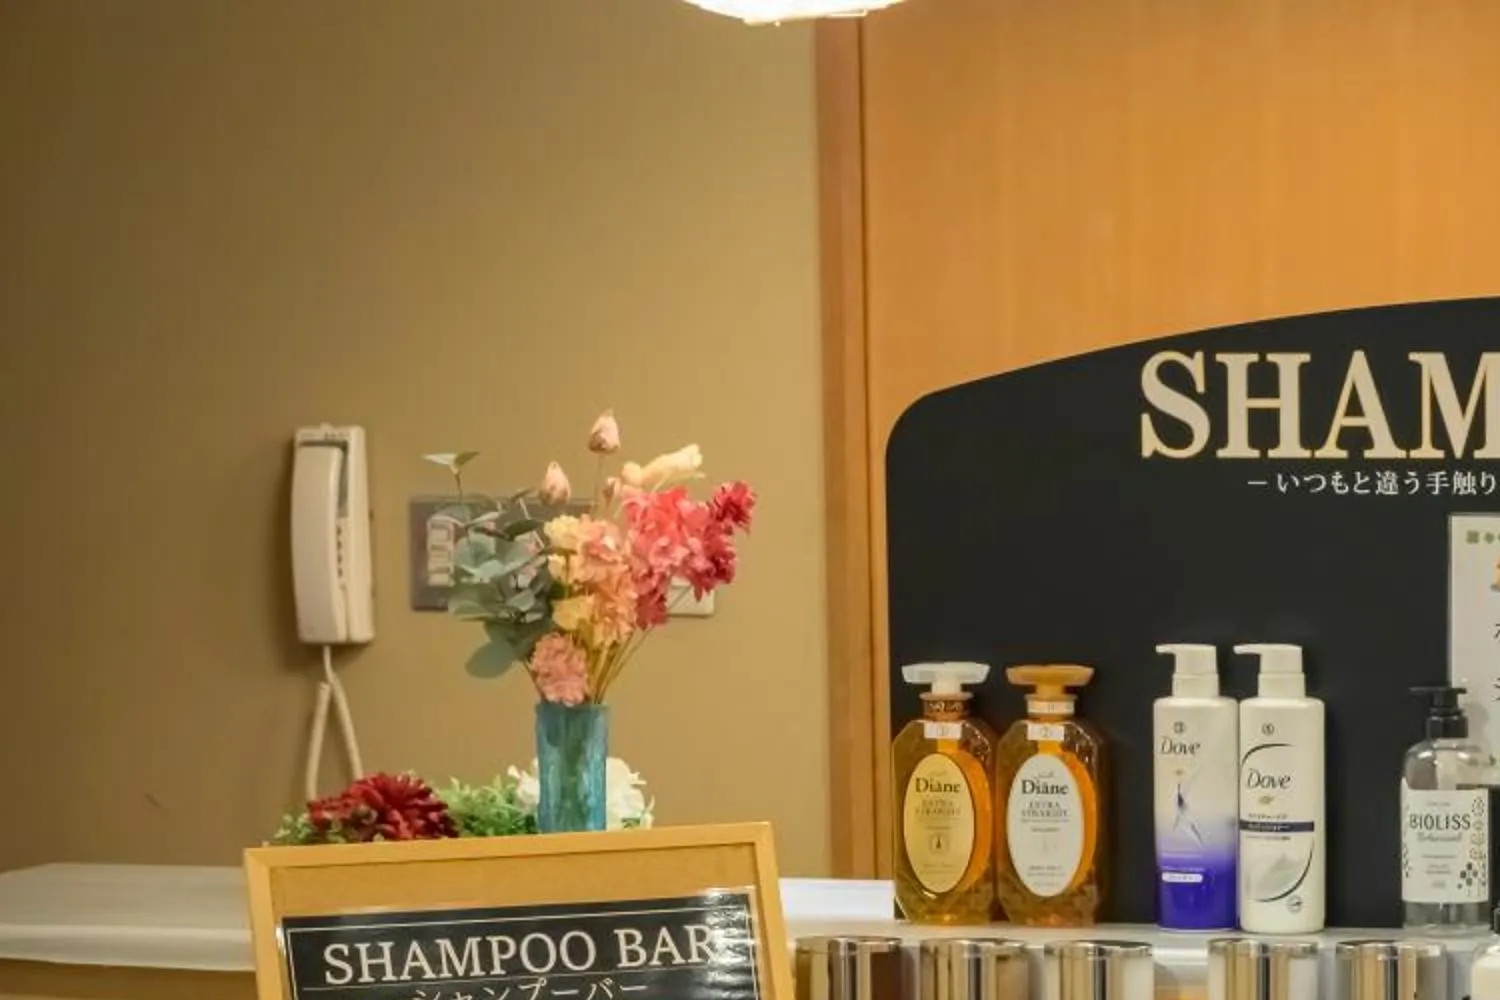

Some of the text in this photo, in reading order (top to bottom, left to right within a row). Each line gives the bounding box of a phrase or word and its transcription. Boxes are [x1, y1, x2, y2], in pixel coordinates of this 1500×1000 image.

[1161, 736, 1201, 755] Dove
[1247, 769, 1291, 789] Dove
[1409, 814, 1471, 831] BIOLISS
[323, 924, 717, 985] SHAMPOO BAR
